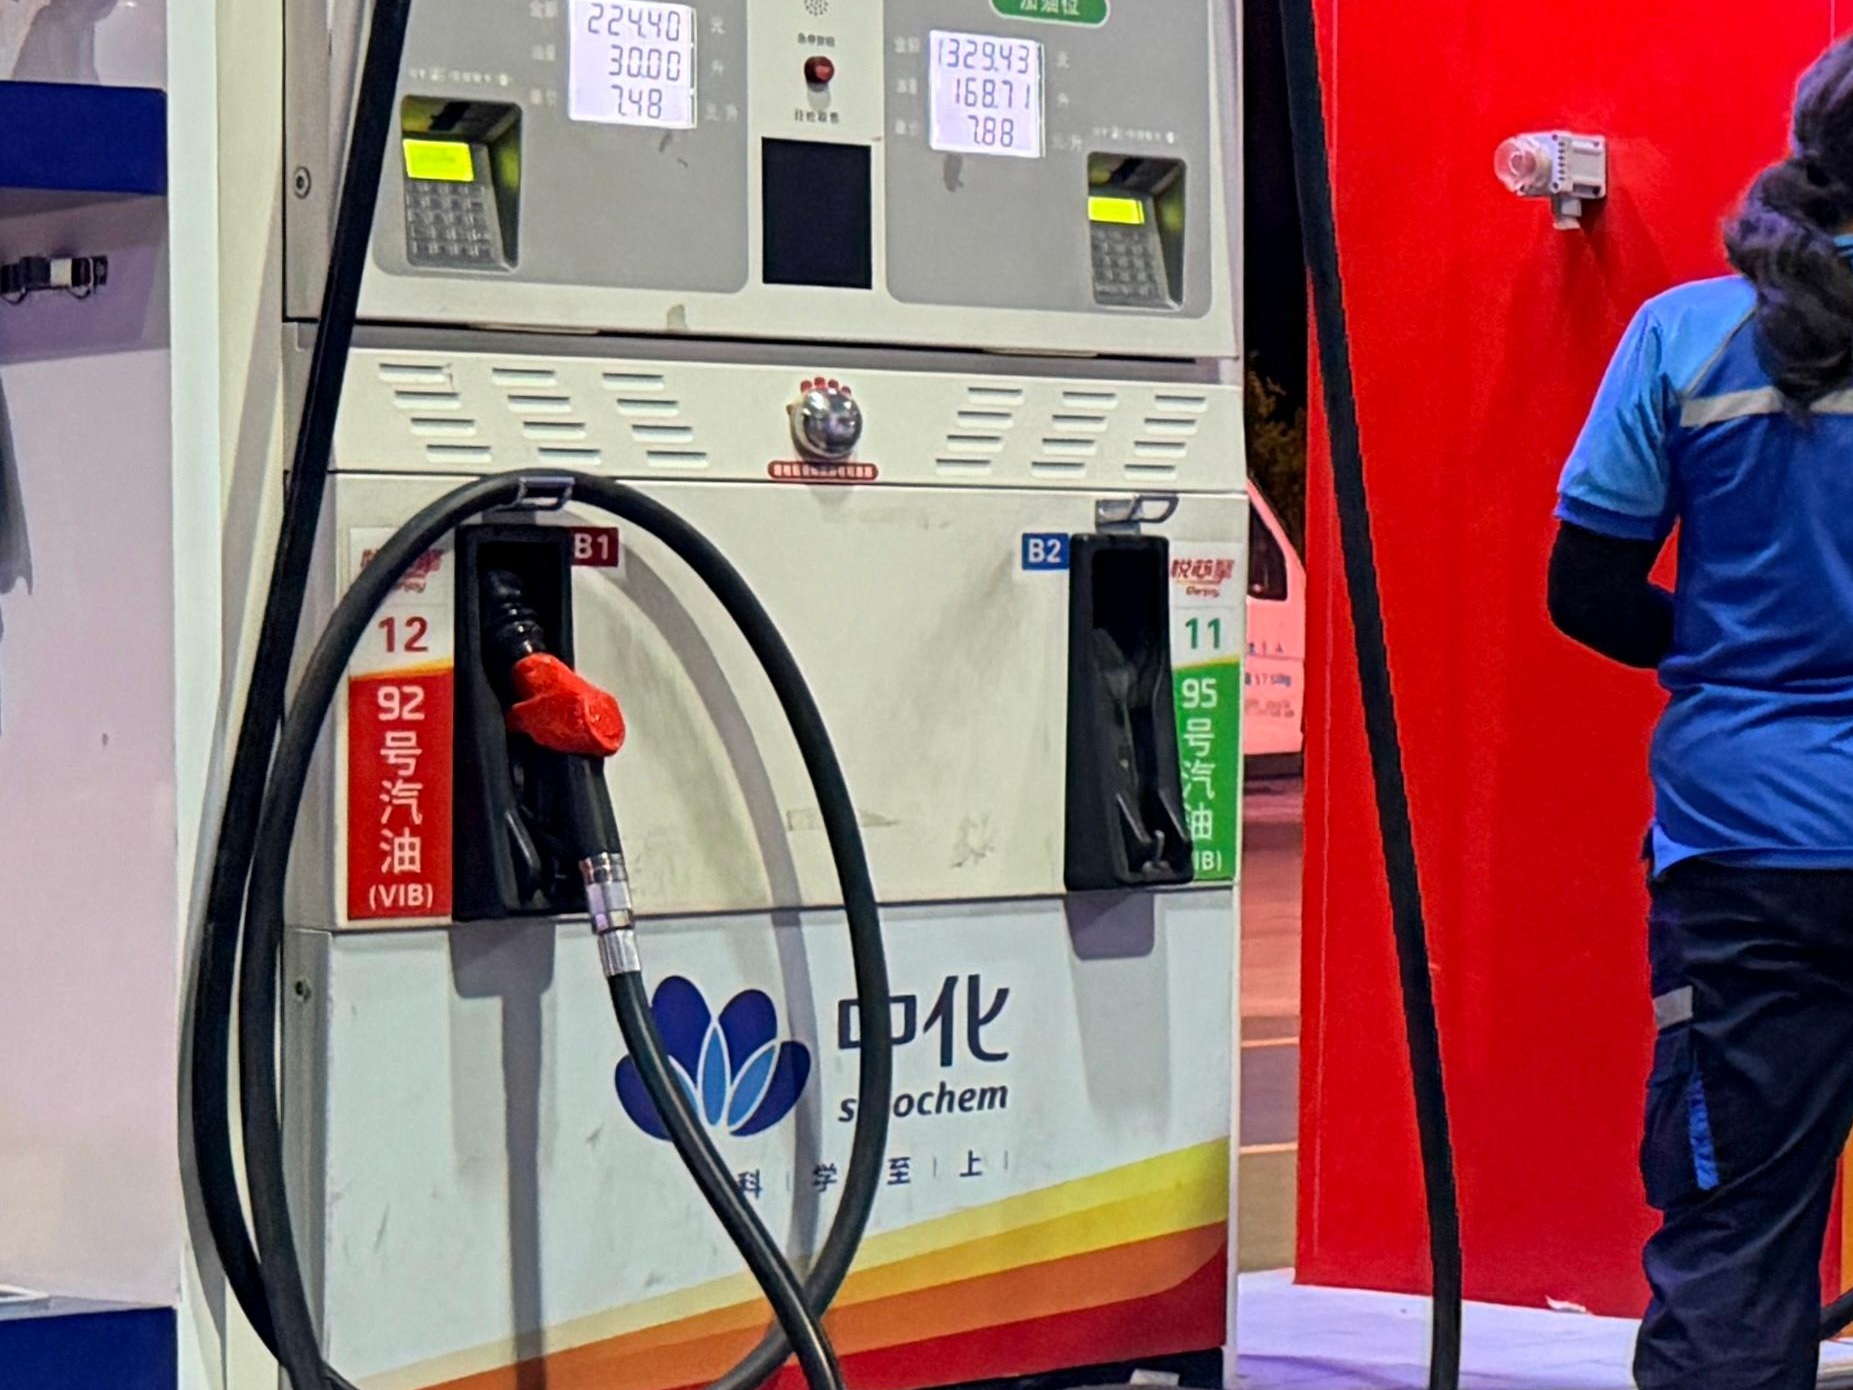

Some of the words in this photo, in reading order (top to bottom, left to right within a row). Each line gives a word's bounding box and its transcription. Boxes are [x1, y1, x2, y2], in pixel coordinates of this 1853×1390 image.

[573, 533, 609, 561] B1
[1026, 538, 1062, 564] B2
[377, 615, 429, 654] 12
[1184, 616, 1222, 651] 11
[837, 1080, 1009, 1123] sochem
